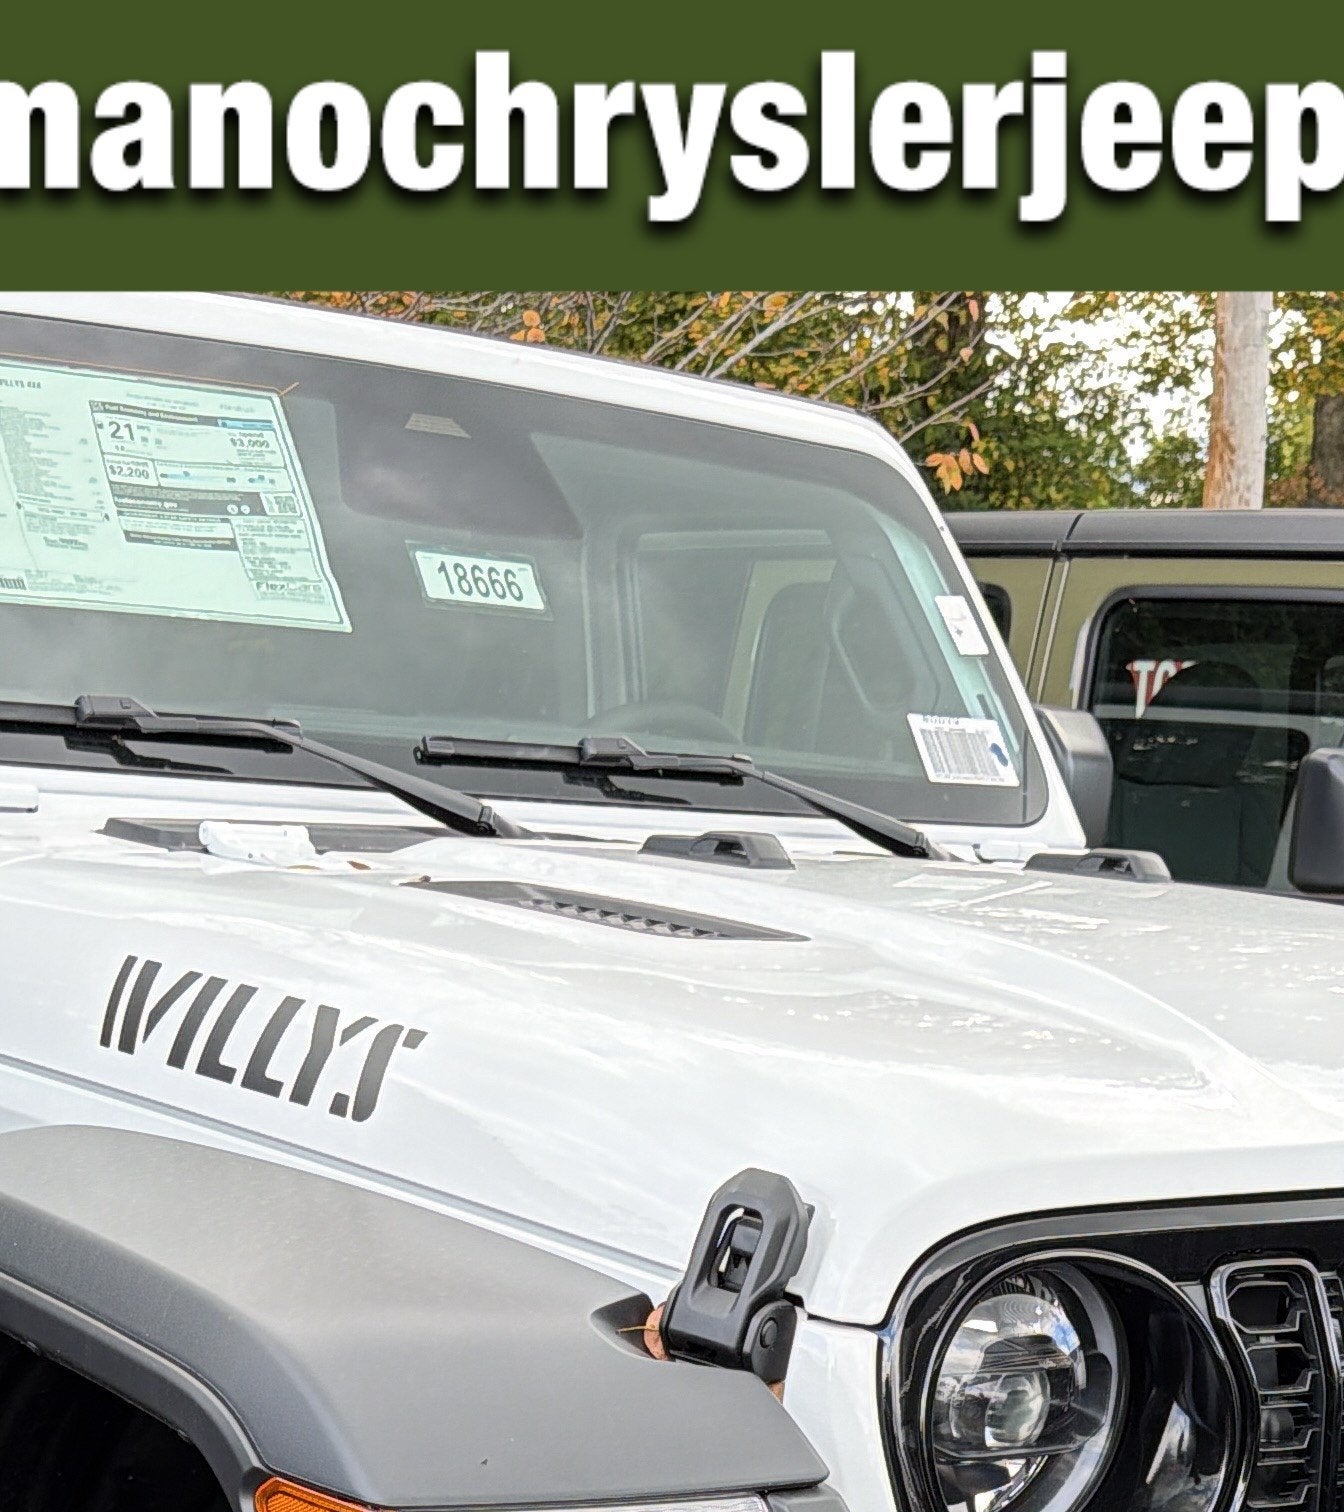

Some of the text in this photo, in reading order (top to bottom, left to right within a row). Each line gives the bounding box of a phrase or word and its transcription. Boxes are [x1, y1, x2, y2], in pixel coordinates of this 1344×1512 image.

[108, 420, 135, 442] 21
[438, 560, 524, 602] 18666
[100, 954, 429, 1123] WILLYS
